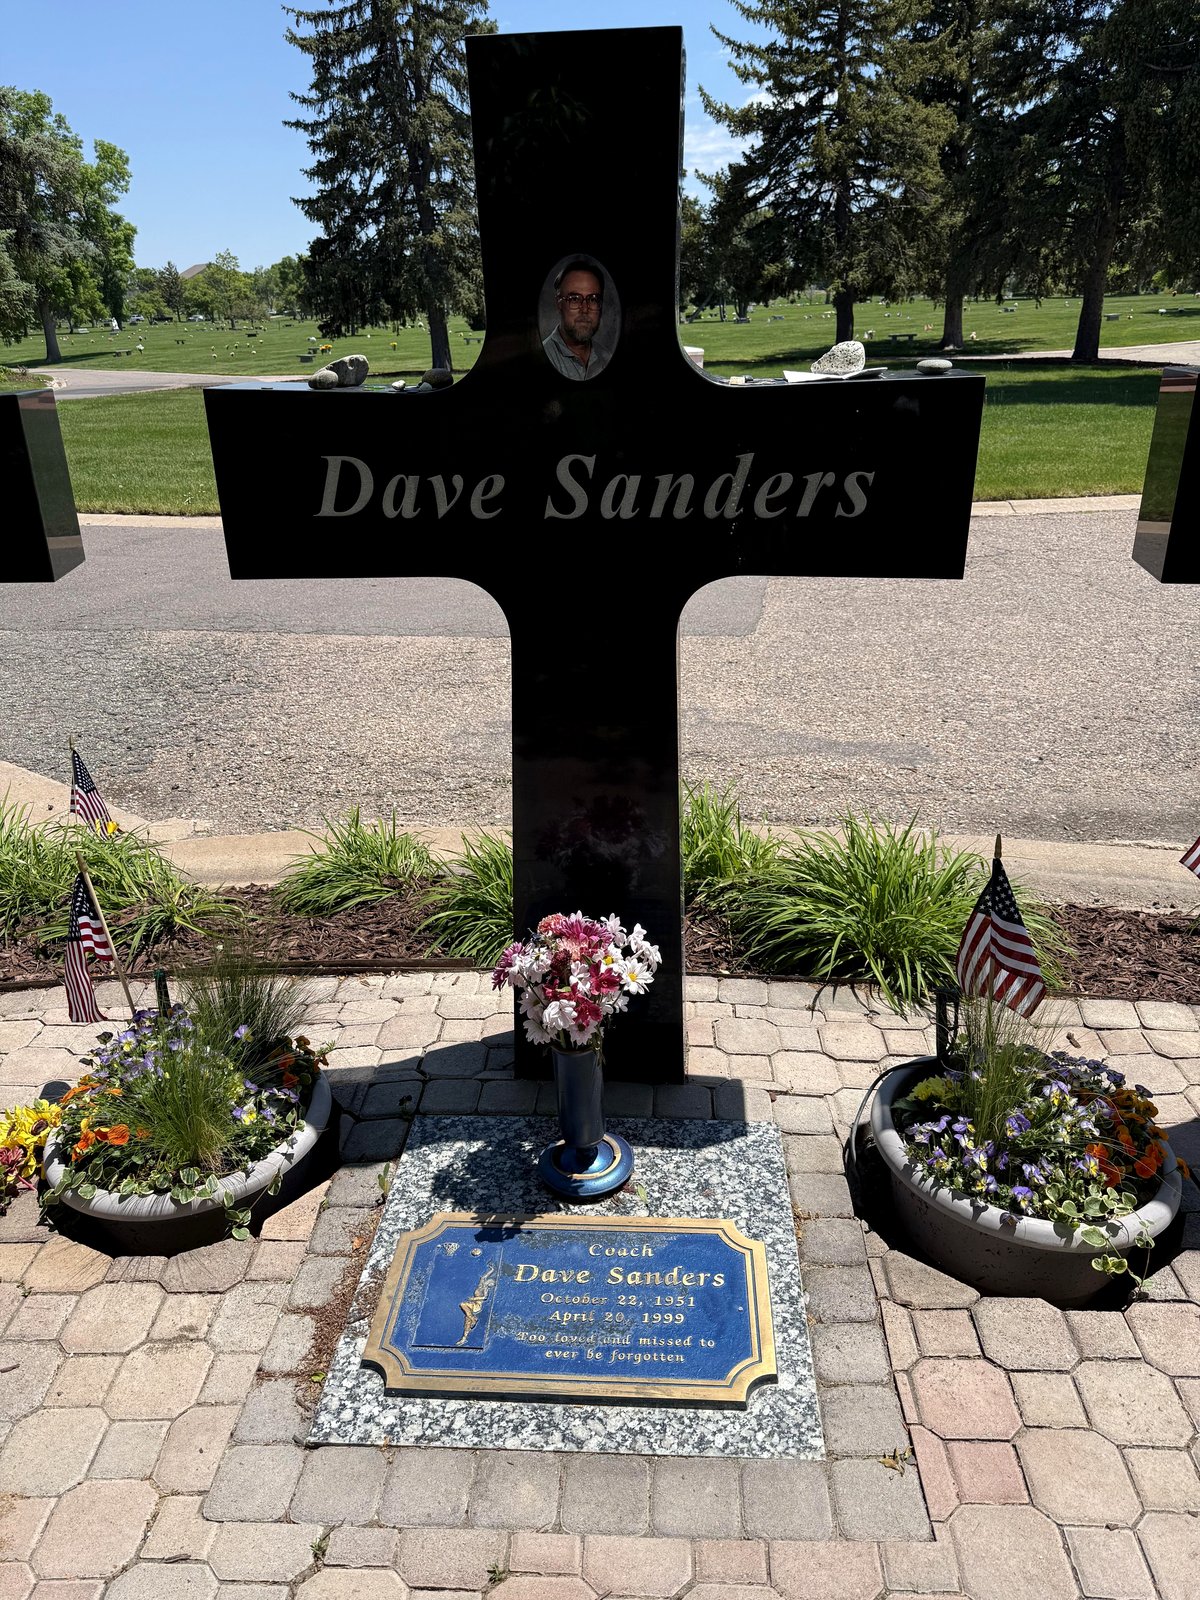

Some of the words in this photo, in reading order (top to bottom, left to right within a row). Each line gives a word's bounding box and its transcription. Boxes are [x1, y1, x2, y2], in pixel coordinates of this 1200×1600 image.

[314, 455, 505, 519] Dave
[544, 453, 876, 519] Sanders
[588, 1243, 654, 1257] Coach
[514, 1264, 591, 1284] Dave
[607, 1266, 725, 1287] Sanders
[540, 1292, 608, 1305] October
[617, 1294, 644, 1307] 22,
[654, 1295, 696, 1307] 1951
[549, 1310, 594, 1325] April
[642, 1312, 685, 1324] 1999
[516, 1331, 546, 1343] Too
[554, 1332, 596, 1344] loved
[603, 1334, 631, 1345] and
[639, 1335, 692, 1347] missed
[700, 1338, 716, 1348] to
[545, 1349, 578, 1359] ever
[586, 1348, 603, 1361] be
[610, 1349, 685, 1365] forgotten
